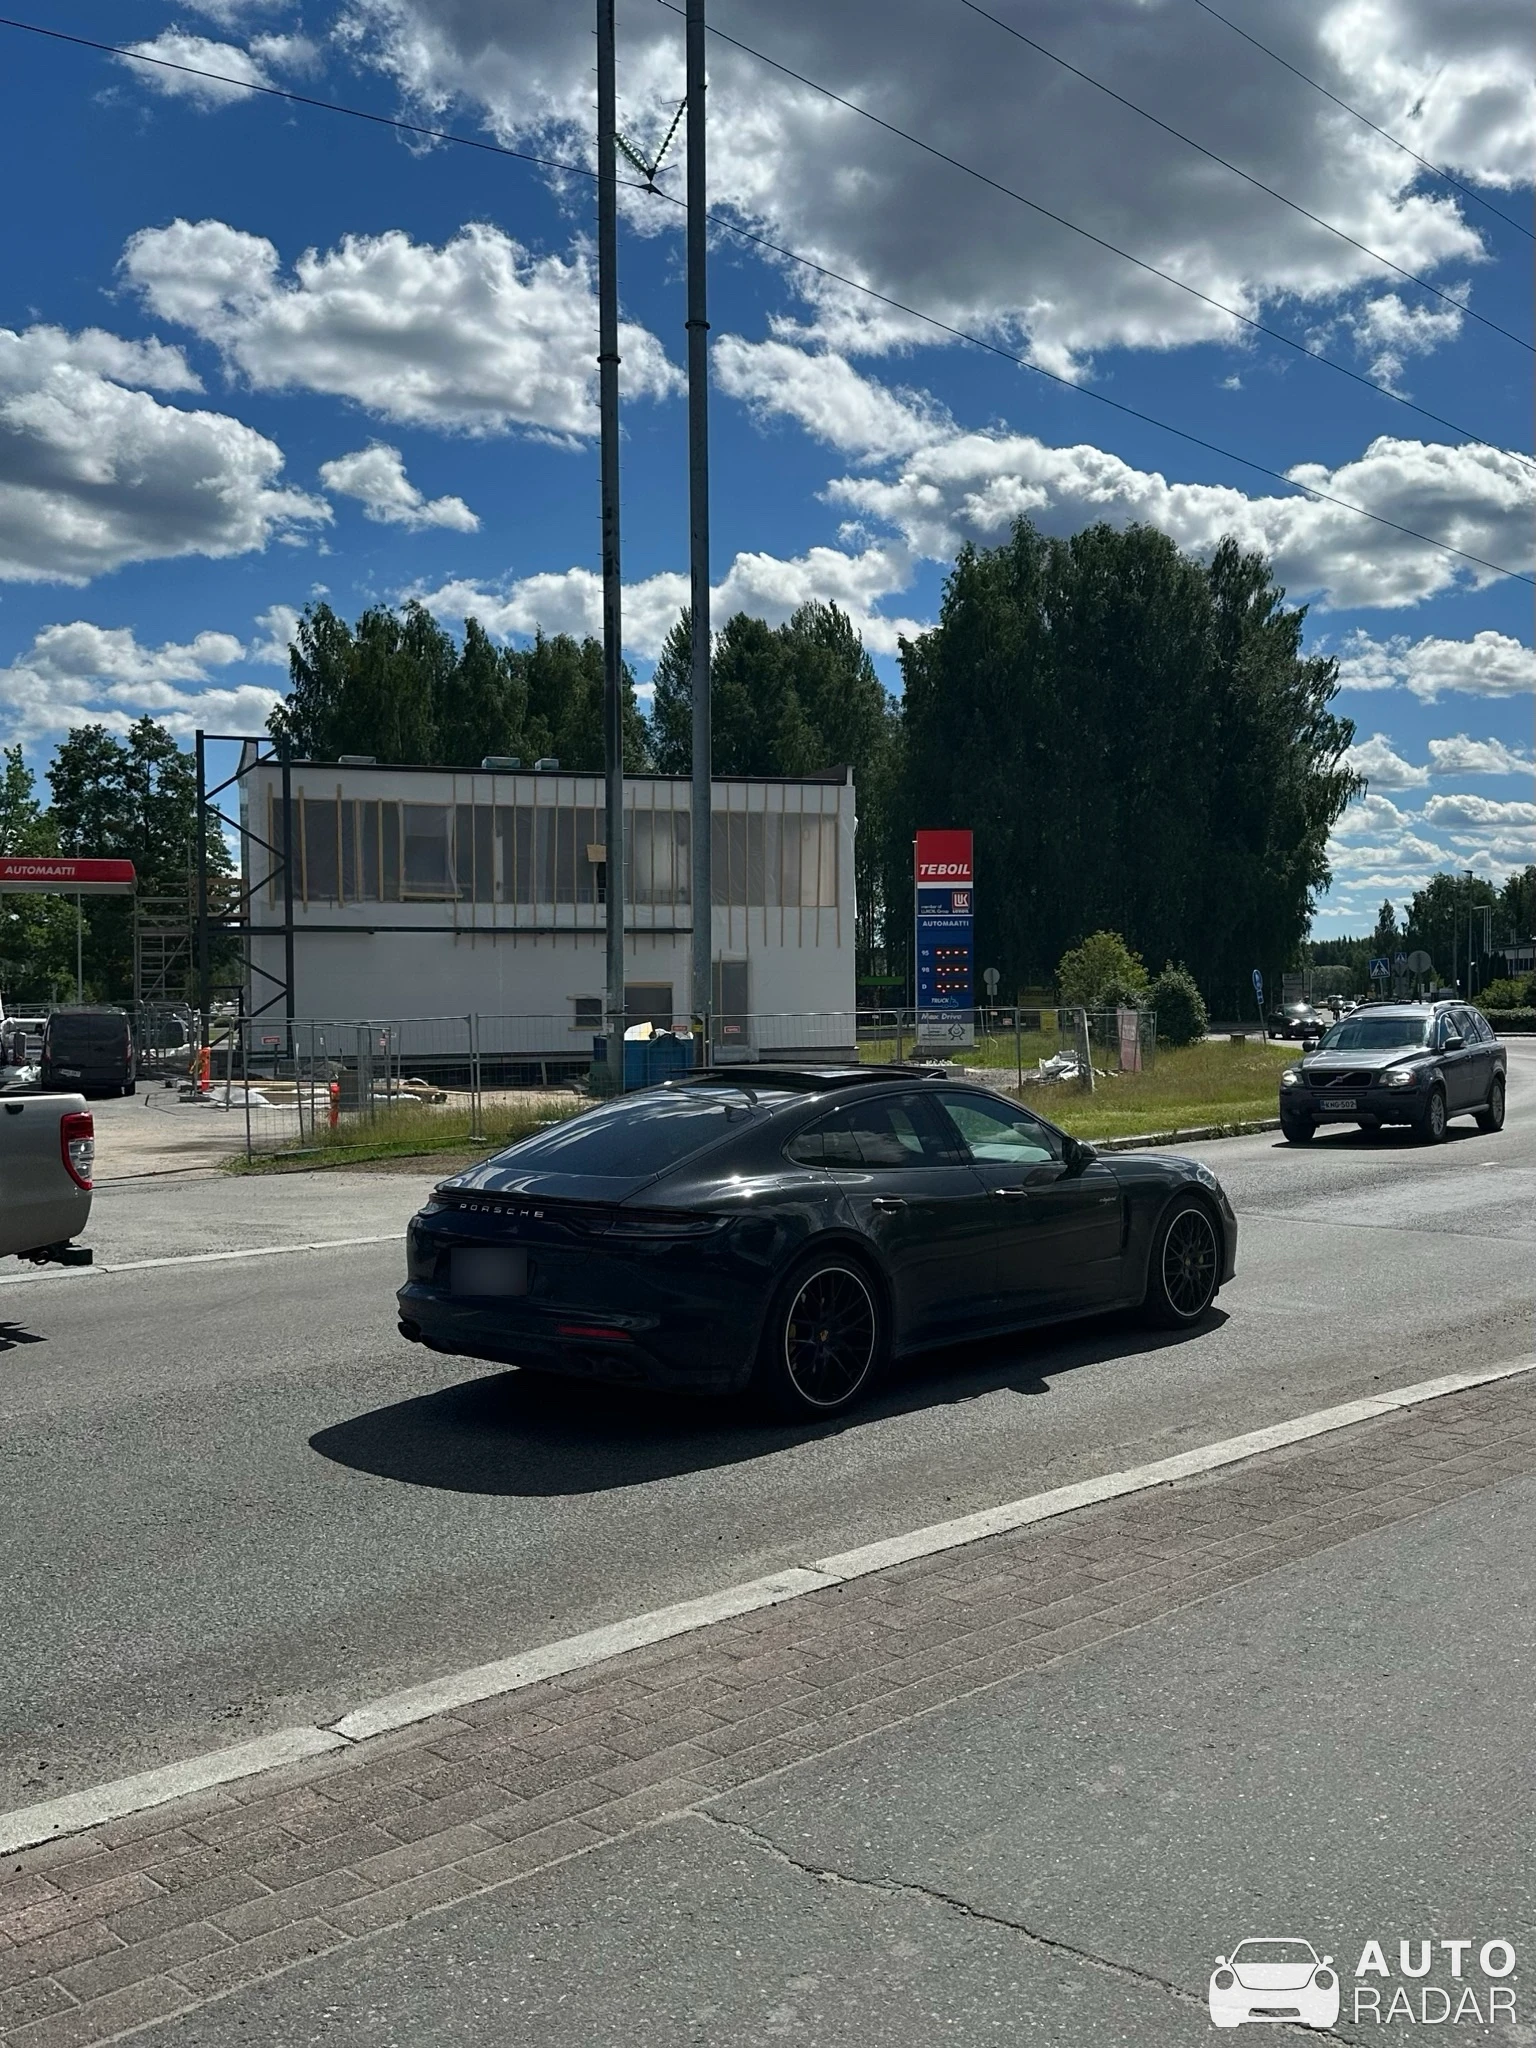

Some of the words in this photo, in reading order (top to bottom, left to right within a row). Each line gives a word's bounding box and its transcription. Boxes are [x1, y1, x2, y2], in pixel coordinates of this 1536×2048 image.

[5, 866, 76, 876] AUTOMAATTI
[919, 863, 971, 875] TEBOIL
[460, 1203, 545, 1218] PORSCHE
